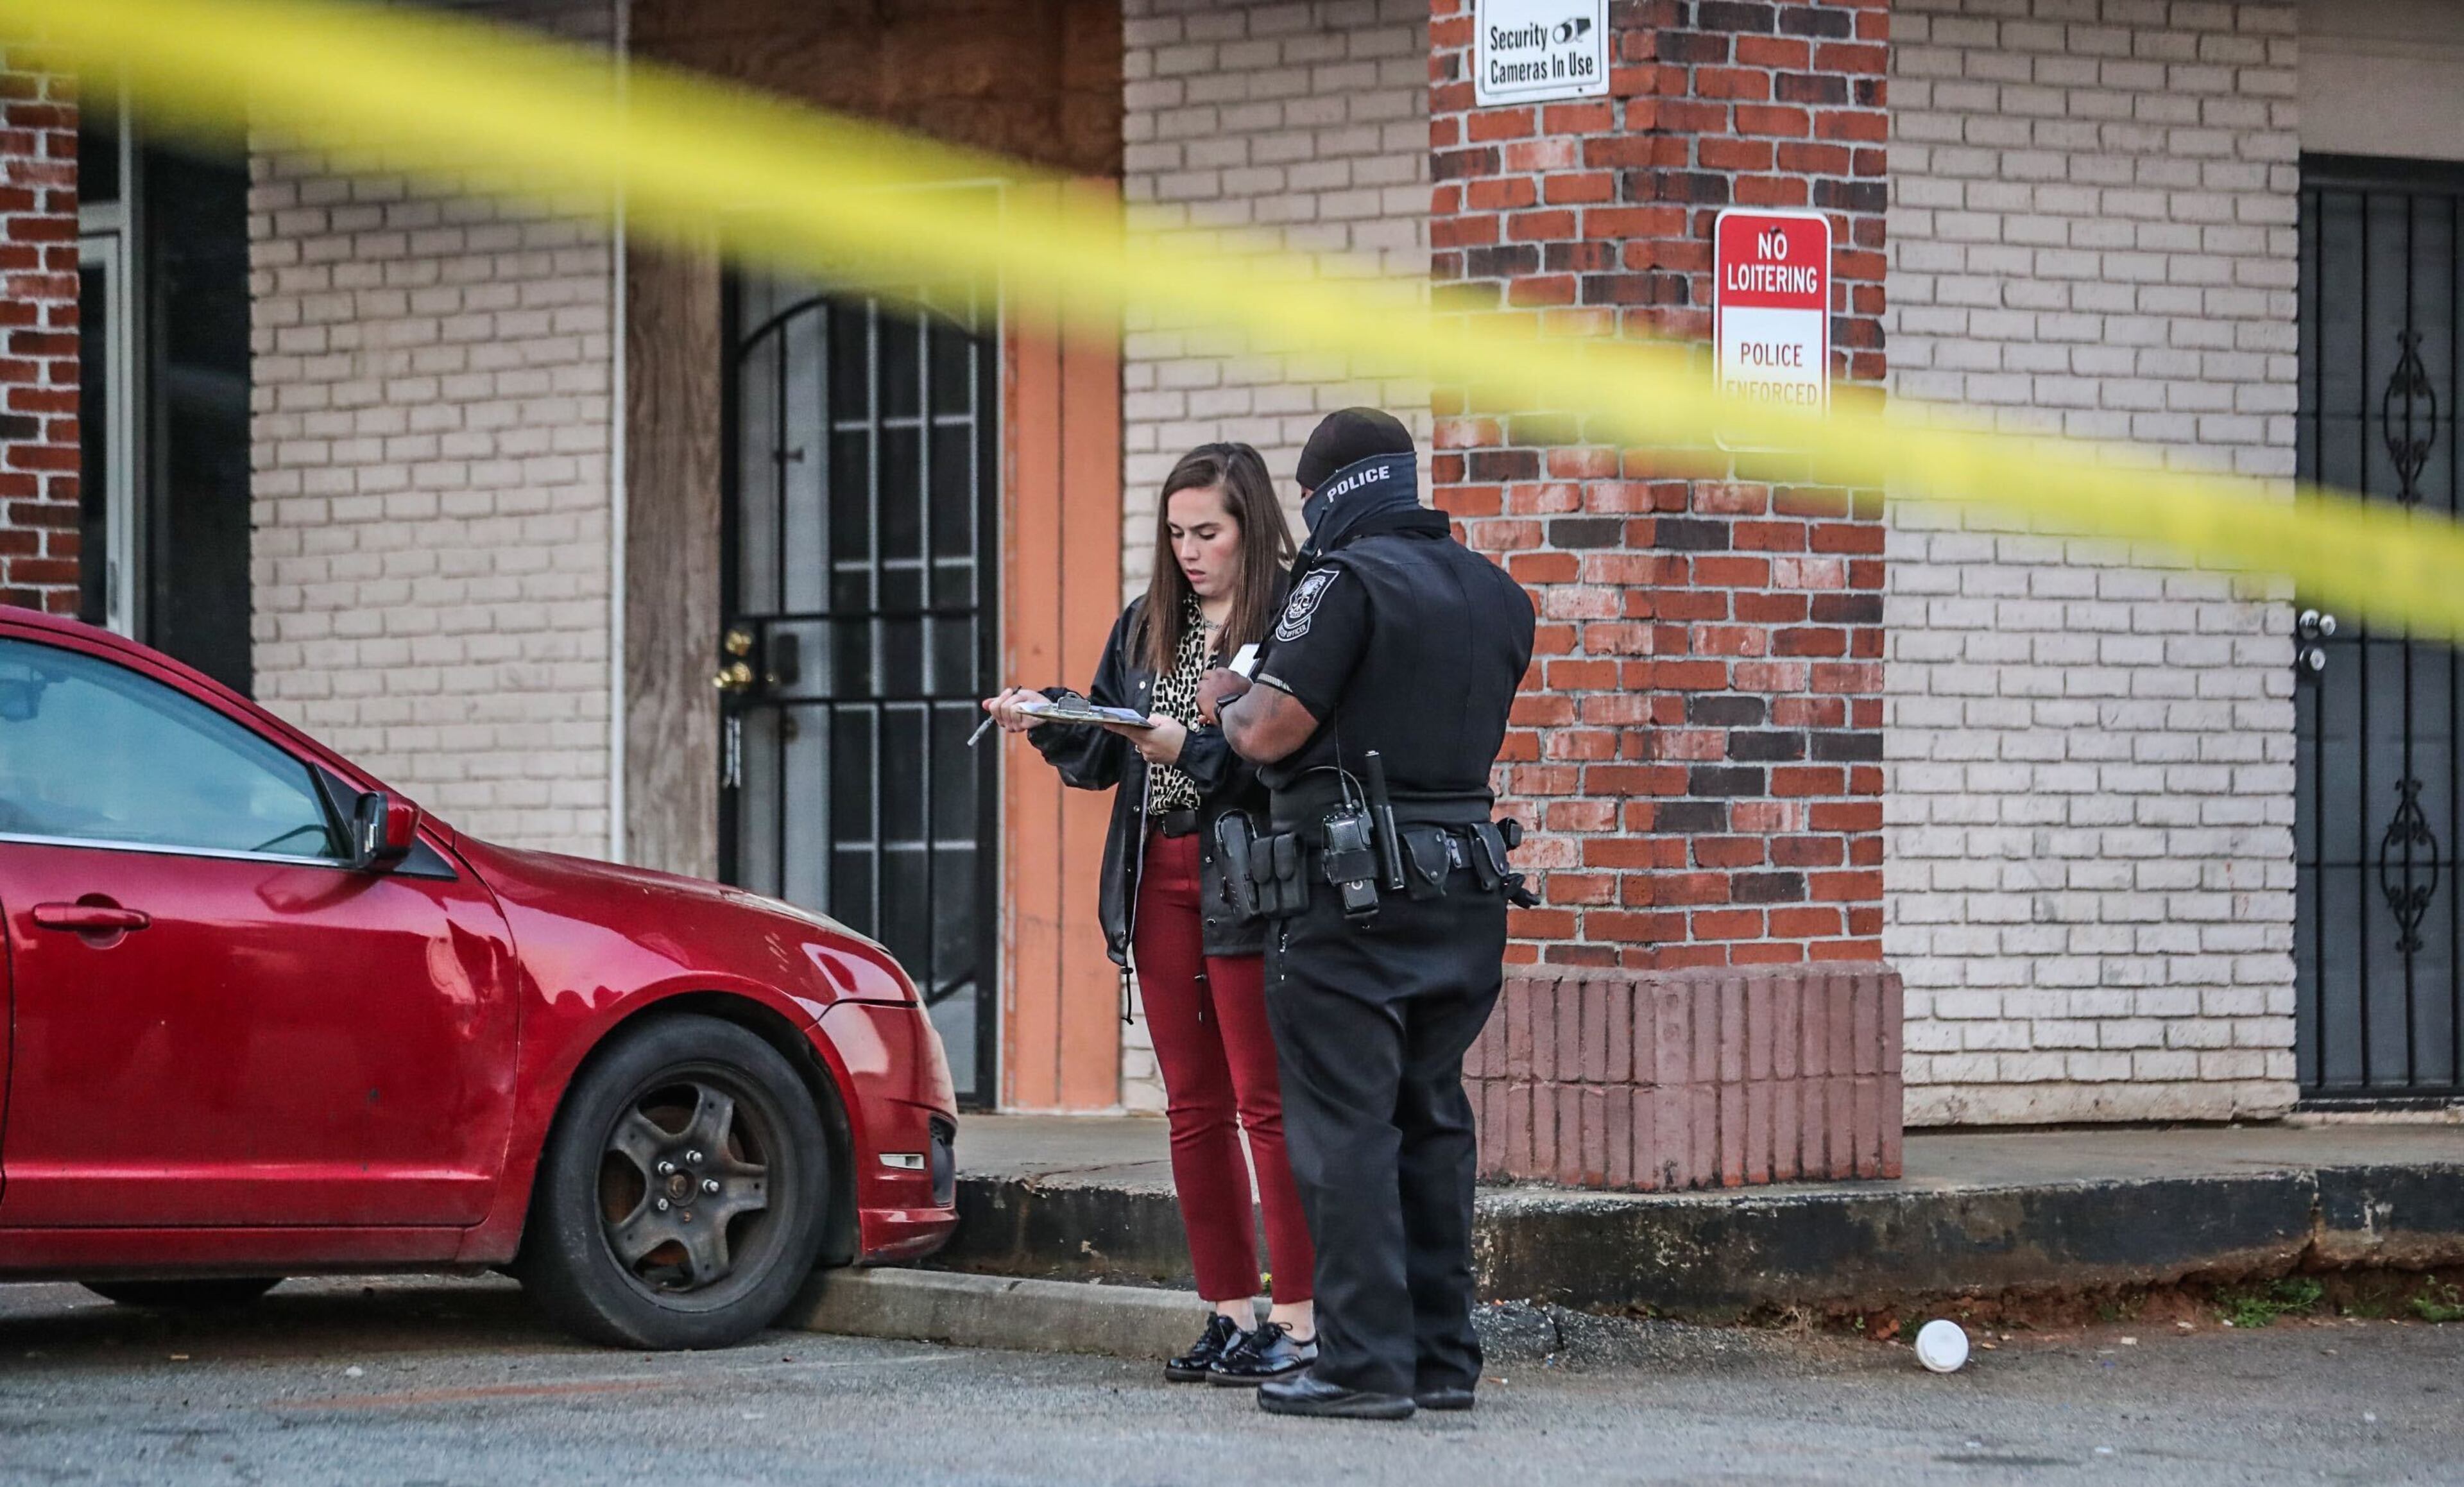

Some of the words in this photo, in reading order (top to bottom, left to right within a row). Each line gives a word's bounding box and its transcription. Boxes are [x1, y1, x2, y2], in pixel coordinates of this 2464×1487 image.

[1491, 22, 1548, 51] Security
[1491, 59, 1548, 84] Cameras
[1552, 54, 1564, 78] In
[1569, 51, 1593, 76] Use
[1758, 232, 1788, 260] NO
[1727, 262, 1817, 294] LOITERING
[1741, 342, 1802, 367] POLICE
[1726, 380, 1817, 406] ENFORCED
[1327, 465, 1390, 503] POLICE
